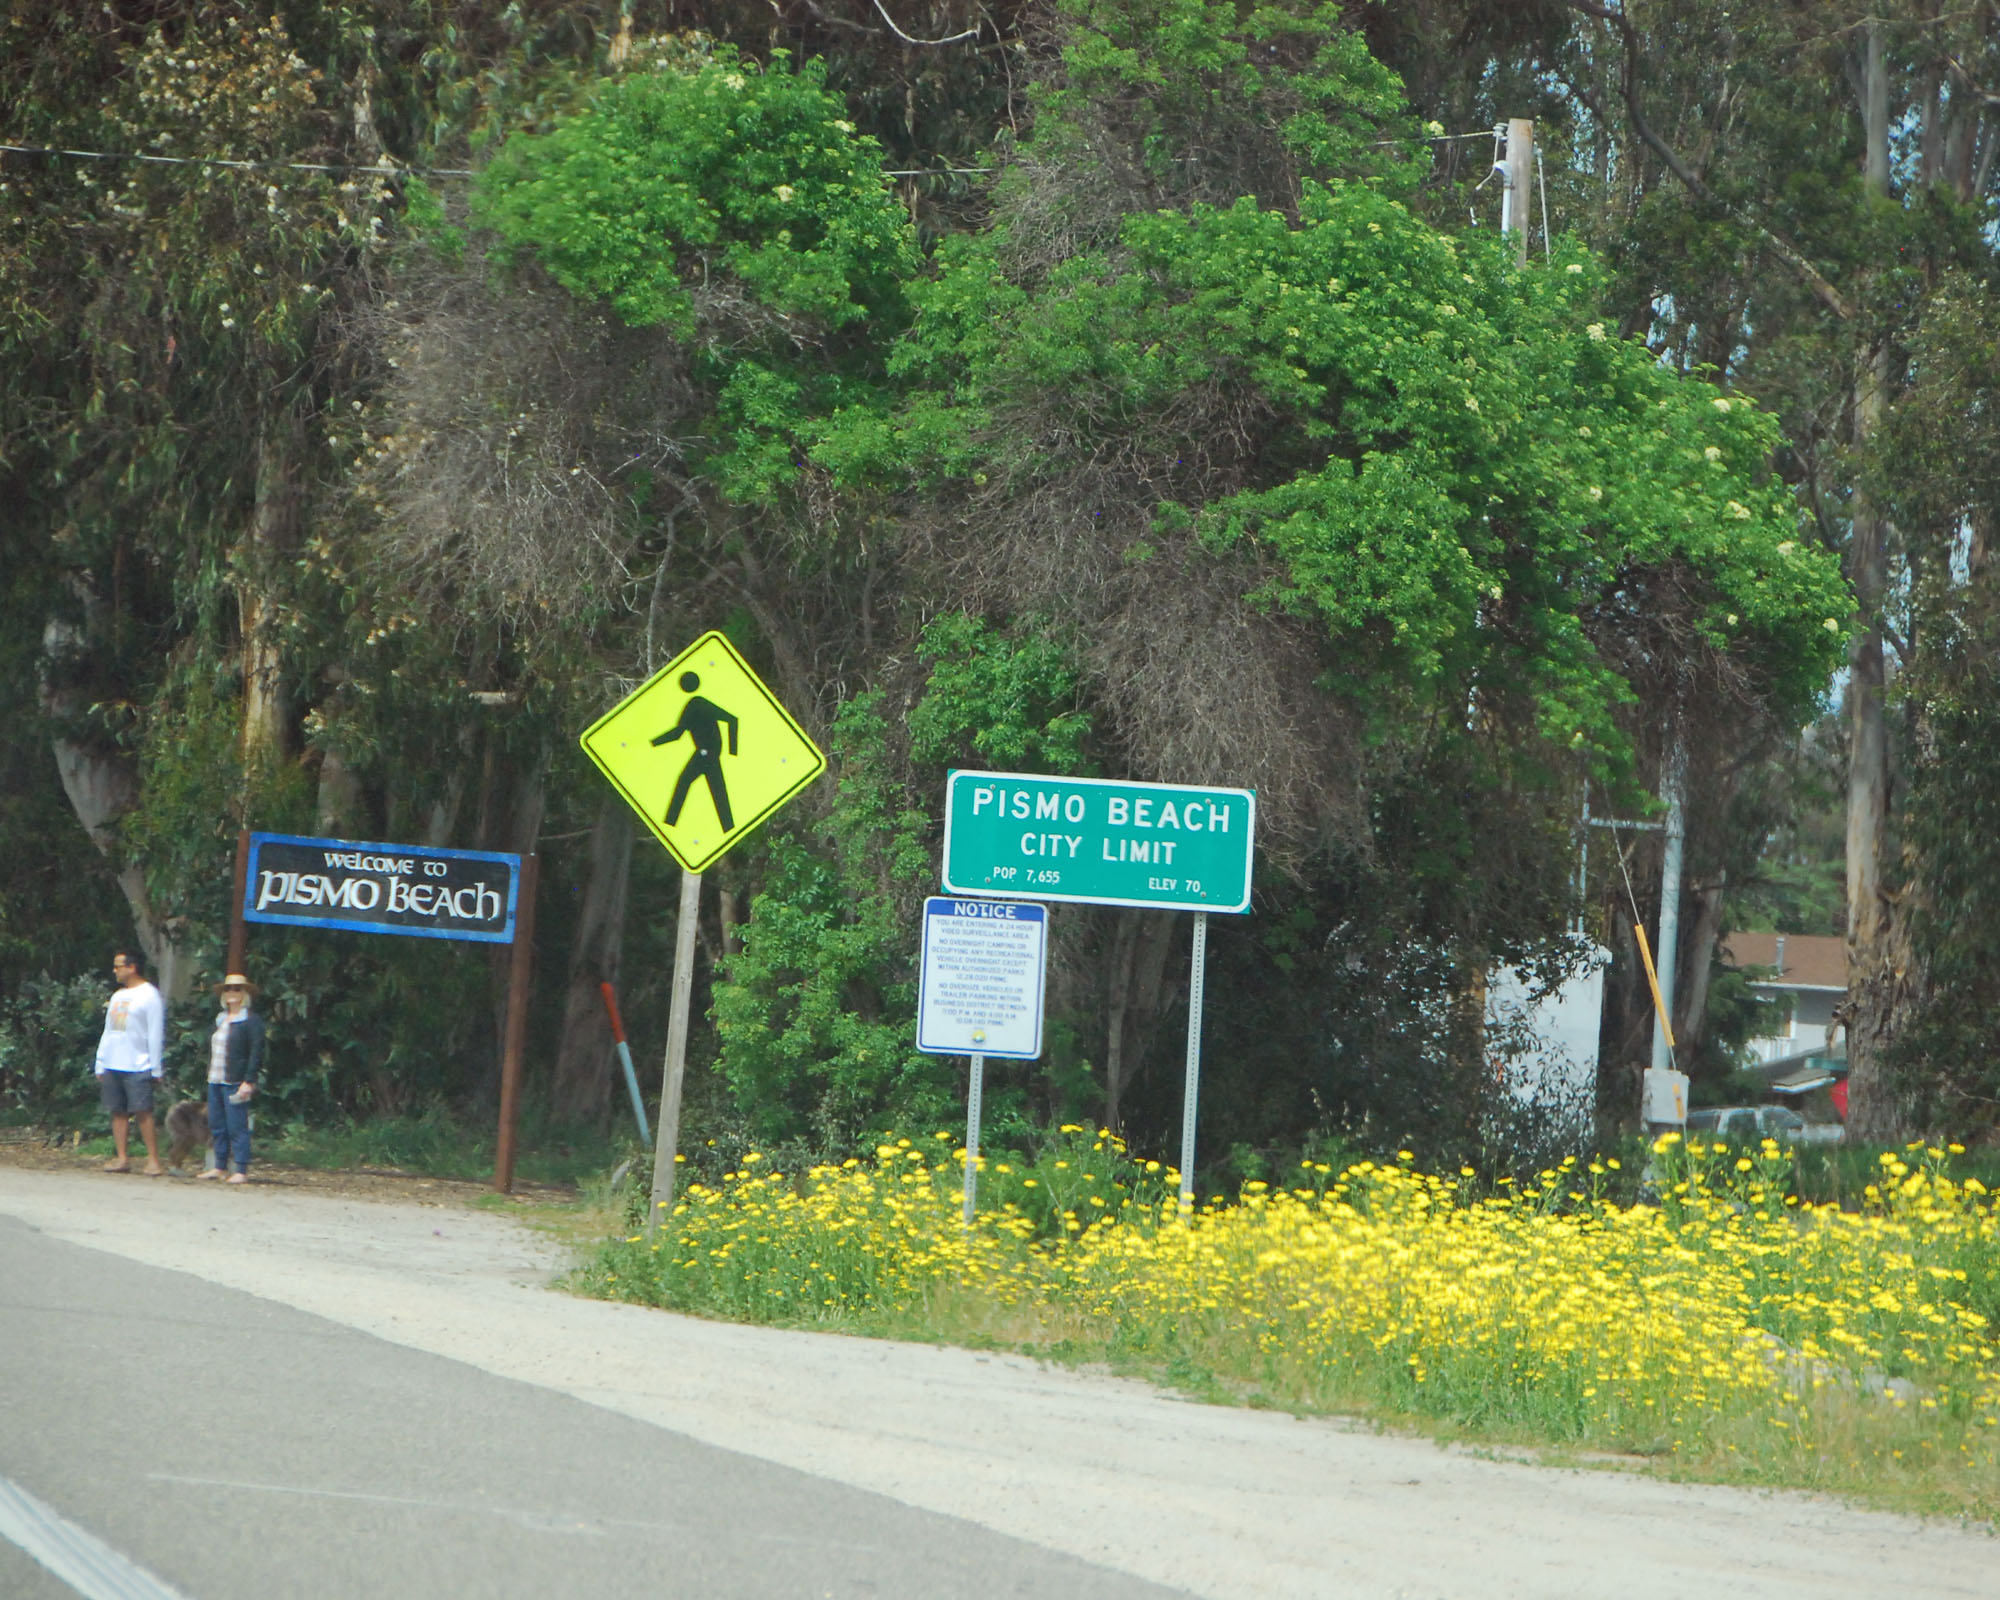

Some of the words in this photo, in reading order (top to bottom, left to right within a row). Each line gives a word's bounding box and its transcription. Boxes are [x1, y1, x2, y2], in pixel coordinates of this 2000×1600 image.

[973, 788, 1085, 823] PISMO
[1108, 798, 1230, 833] BEACH
[1021, 833, 1082, 858] CITY
[1103, 838, 1176, 864] LIMIT
[324, 853, 414, 875] WELCOME
[424, 861, 447, 877] TO
[993, 867, 1017, 879] POP
[1027, 870, 1060, 884] 7,655
[1149, 878, 1176, 891] ELEV
[1186, 880, 1200, 893] 70
[256, 870, 381, 911] PISMO
[386, 876, 500, 921] BEACH
[954, 902, 1016, 919] NOTICE
[963, 929, 1009, 938] SURVEILLANCE
[932, 946, 968, 954] OCCUPYING
[986, 950, 1034, 959] RECREATIONAL
[950, 939, 984, 947] OVERNIGHT
[987, 941, 1015, 949] CAMPING
[937, 955, 963, 963] VEHICLE
[965, 958, 1000, 966] OVERNIGHT
